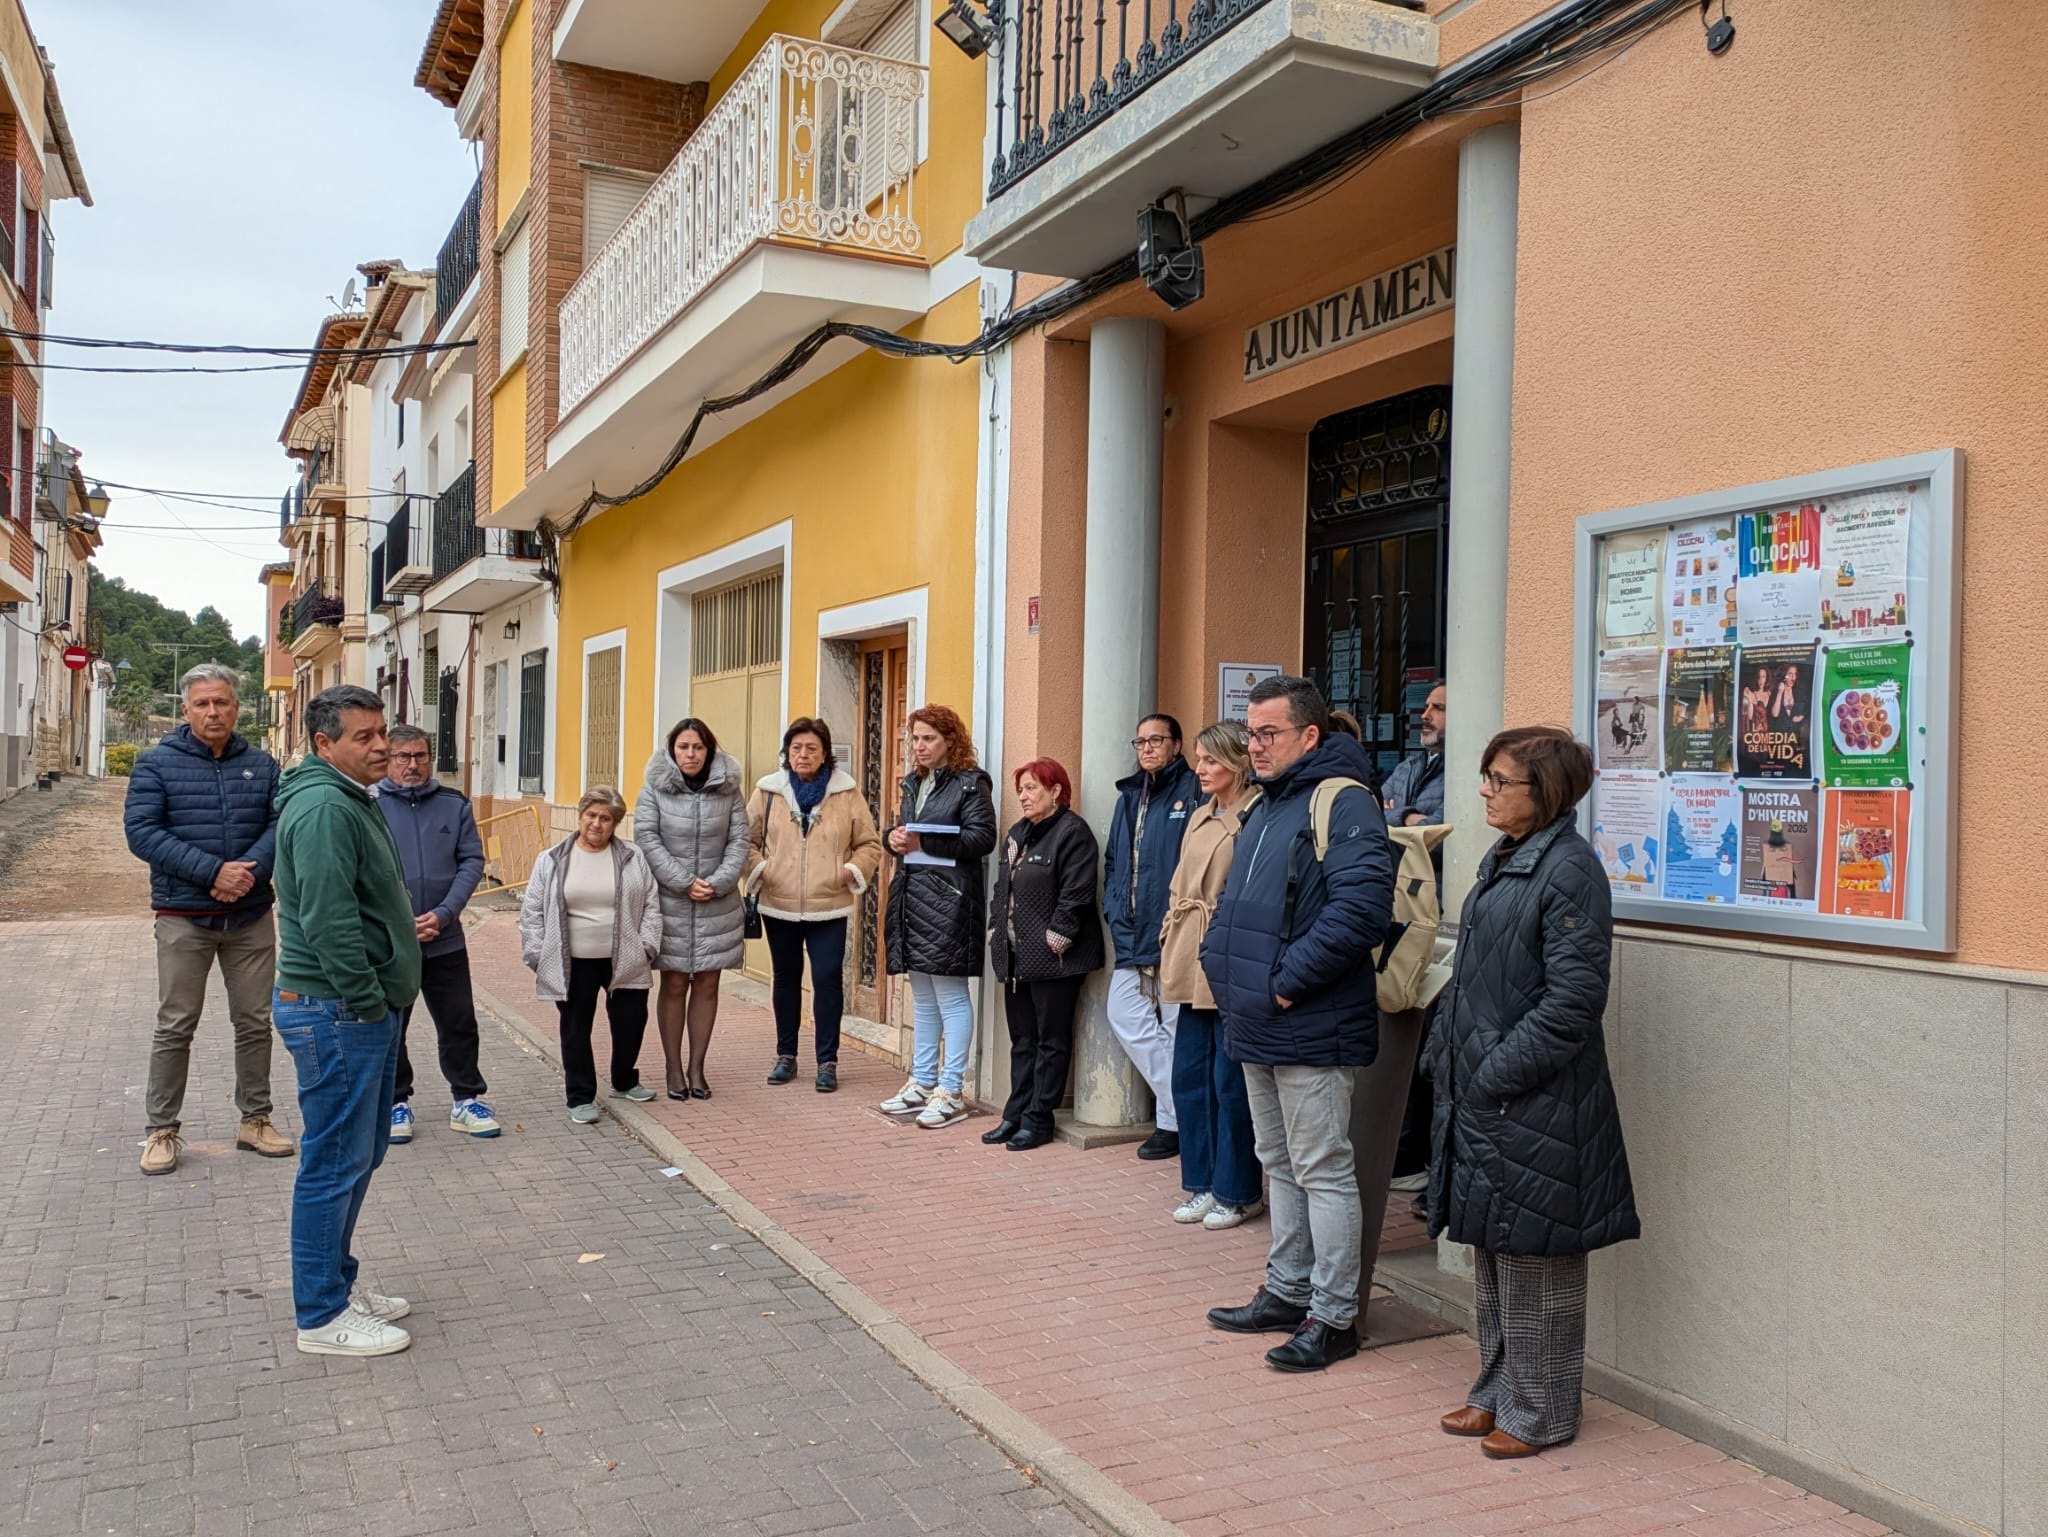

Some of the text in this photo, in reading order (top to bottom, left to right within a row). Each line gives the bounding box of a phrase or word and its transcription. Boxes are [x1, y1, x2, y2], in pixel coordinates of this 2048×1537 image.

[1244, 246, 1456, 376] AJUNTAMEN
[1749, 539, 1810, 565] OLOCAU
[1752, 722, 1763, 732] LA
[1743, 731, 1798, 745] COMEDIA
[1747, 744, 1759, 753] DE
[1767, 744, 1805, 769] VIDA
[1748, 792, 1801, 807] MOSTRA
[1748, 807, 1809, 823] D'HIVERN
[1787, 823, 1808, 834] 2025
